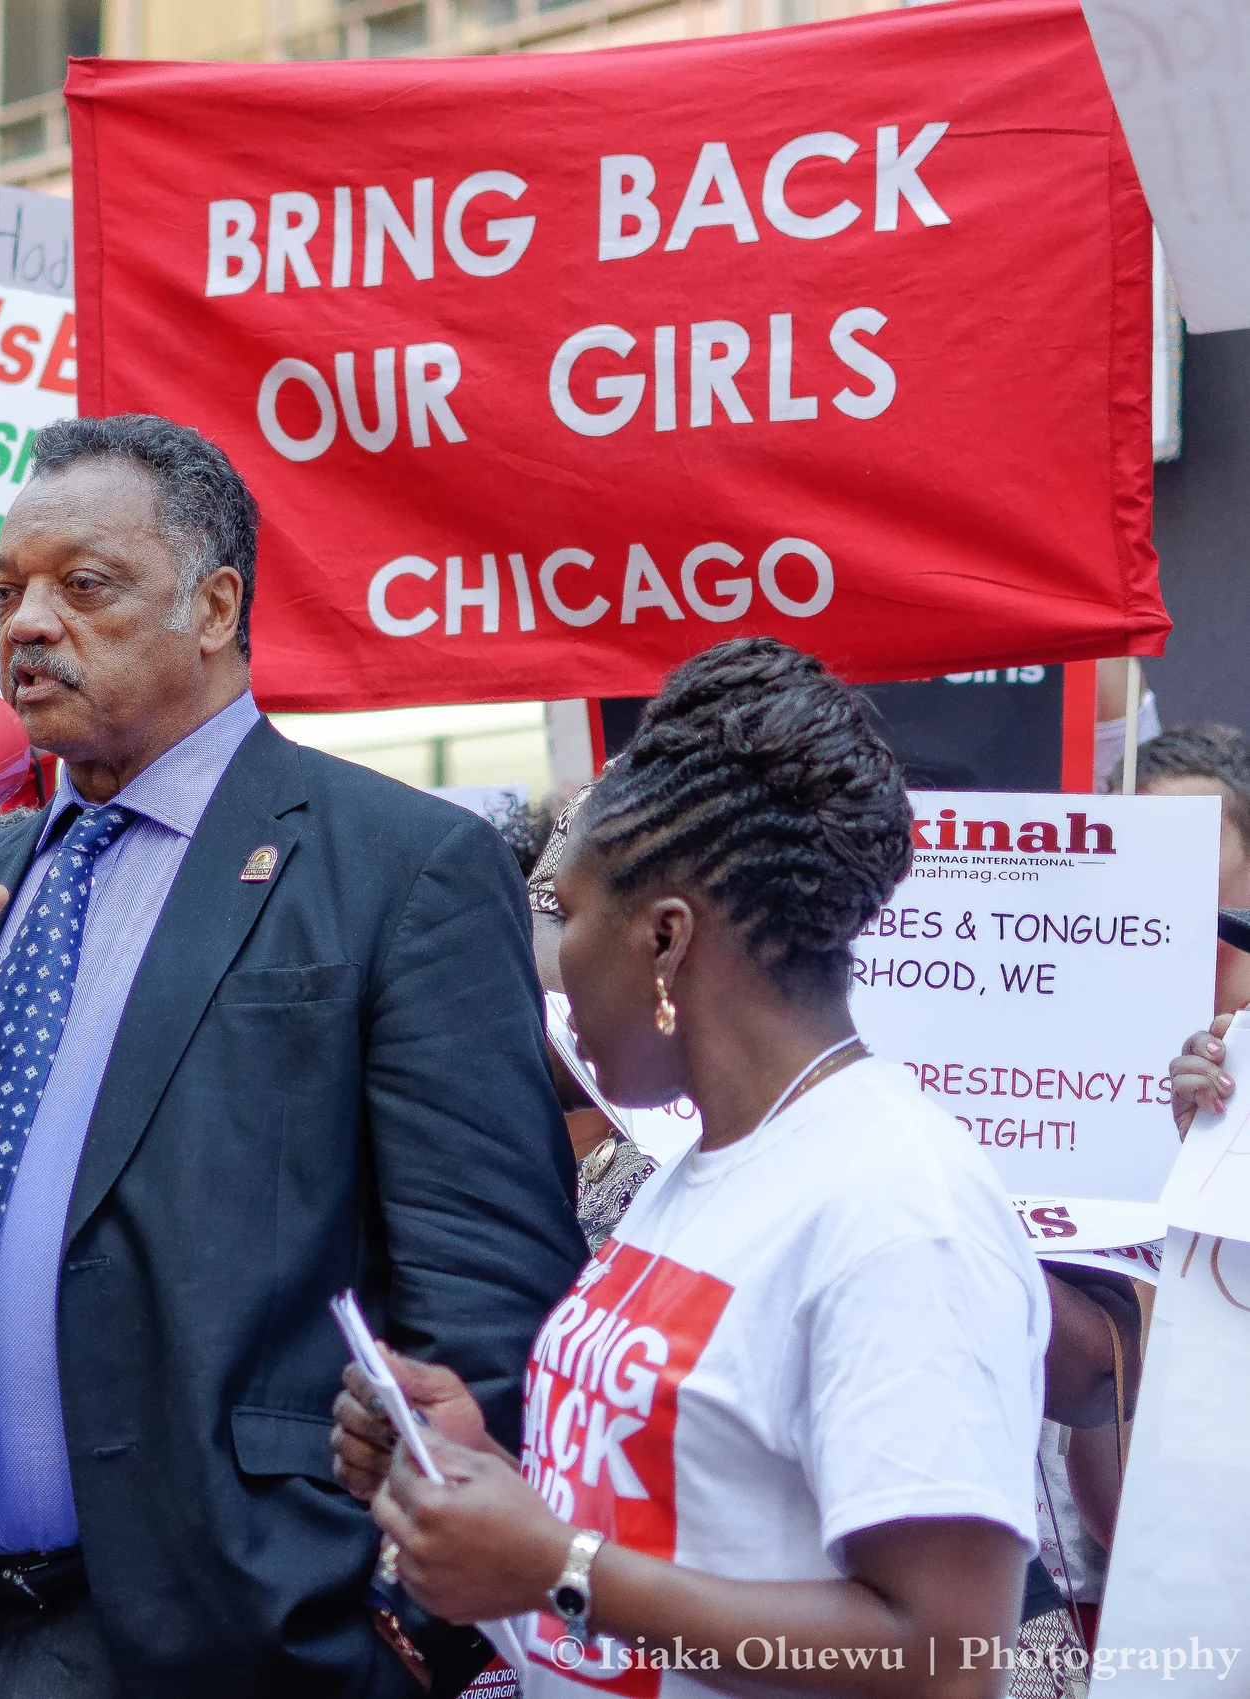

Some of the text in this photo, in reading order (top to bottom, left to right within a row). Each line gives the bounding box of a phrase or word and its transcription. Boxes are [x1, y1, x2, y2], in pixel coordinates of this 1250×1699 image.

[205, 121, 950, 297] BRING BACK
[256, 306, 897, 462] OUR GIRLS
[368, 536, 835, 637] CHICAGO
[908, 867, 1039, 883] inahmag.com
[914, 855, 1074, 867] ORYMAG INTERNATIONAL
[860, 908, 1171, 946] IBES & TONGUES:
[851, 958, 1057, 996] RHOOD, WE
